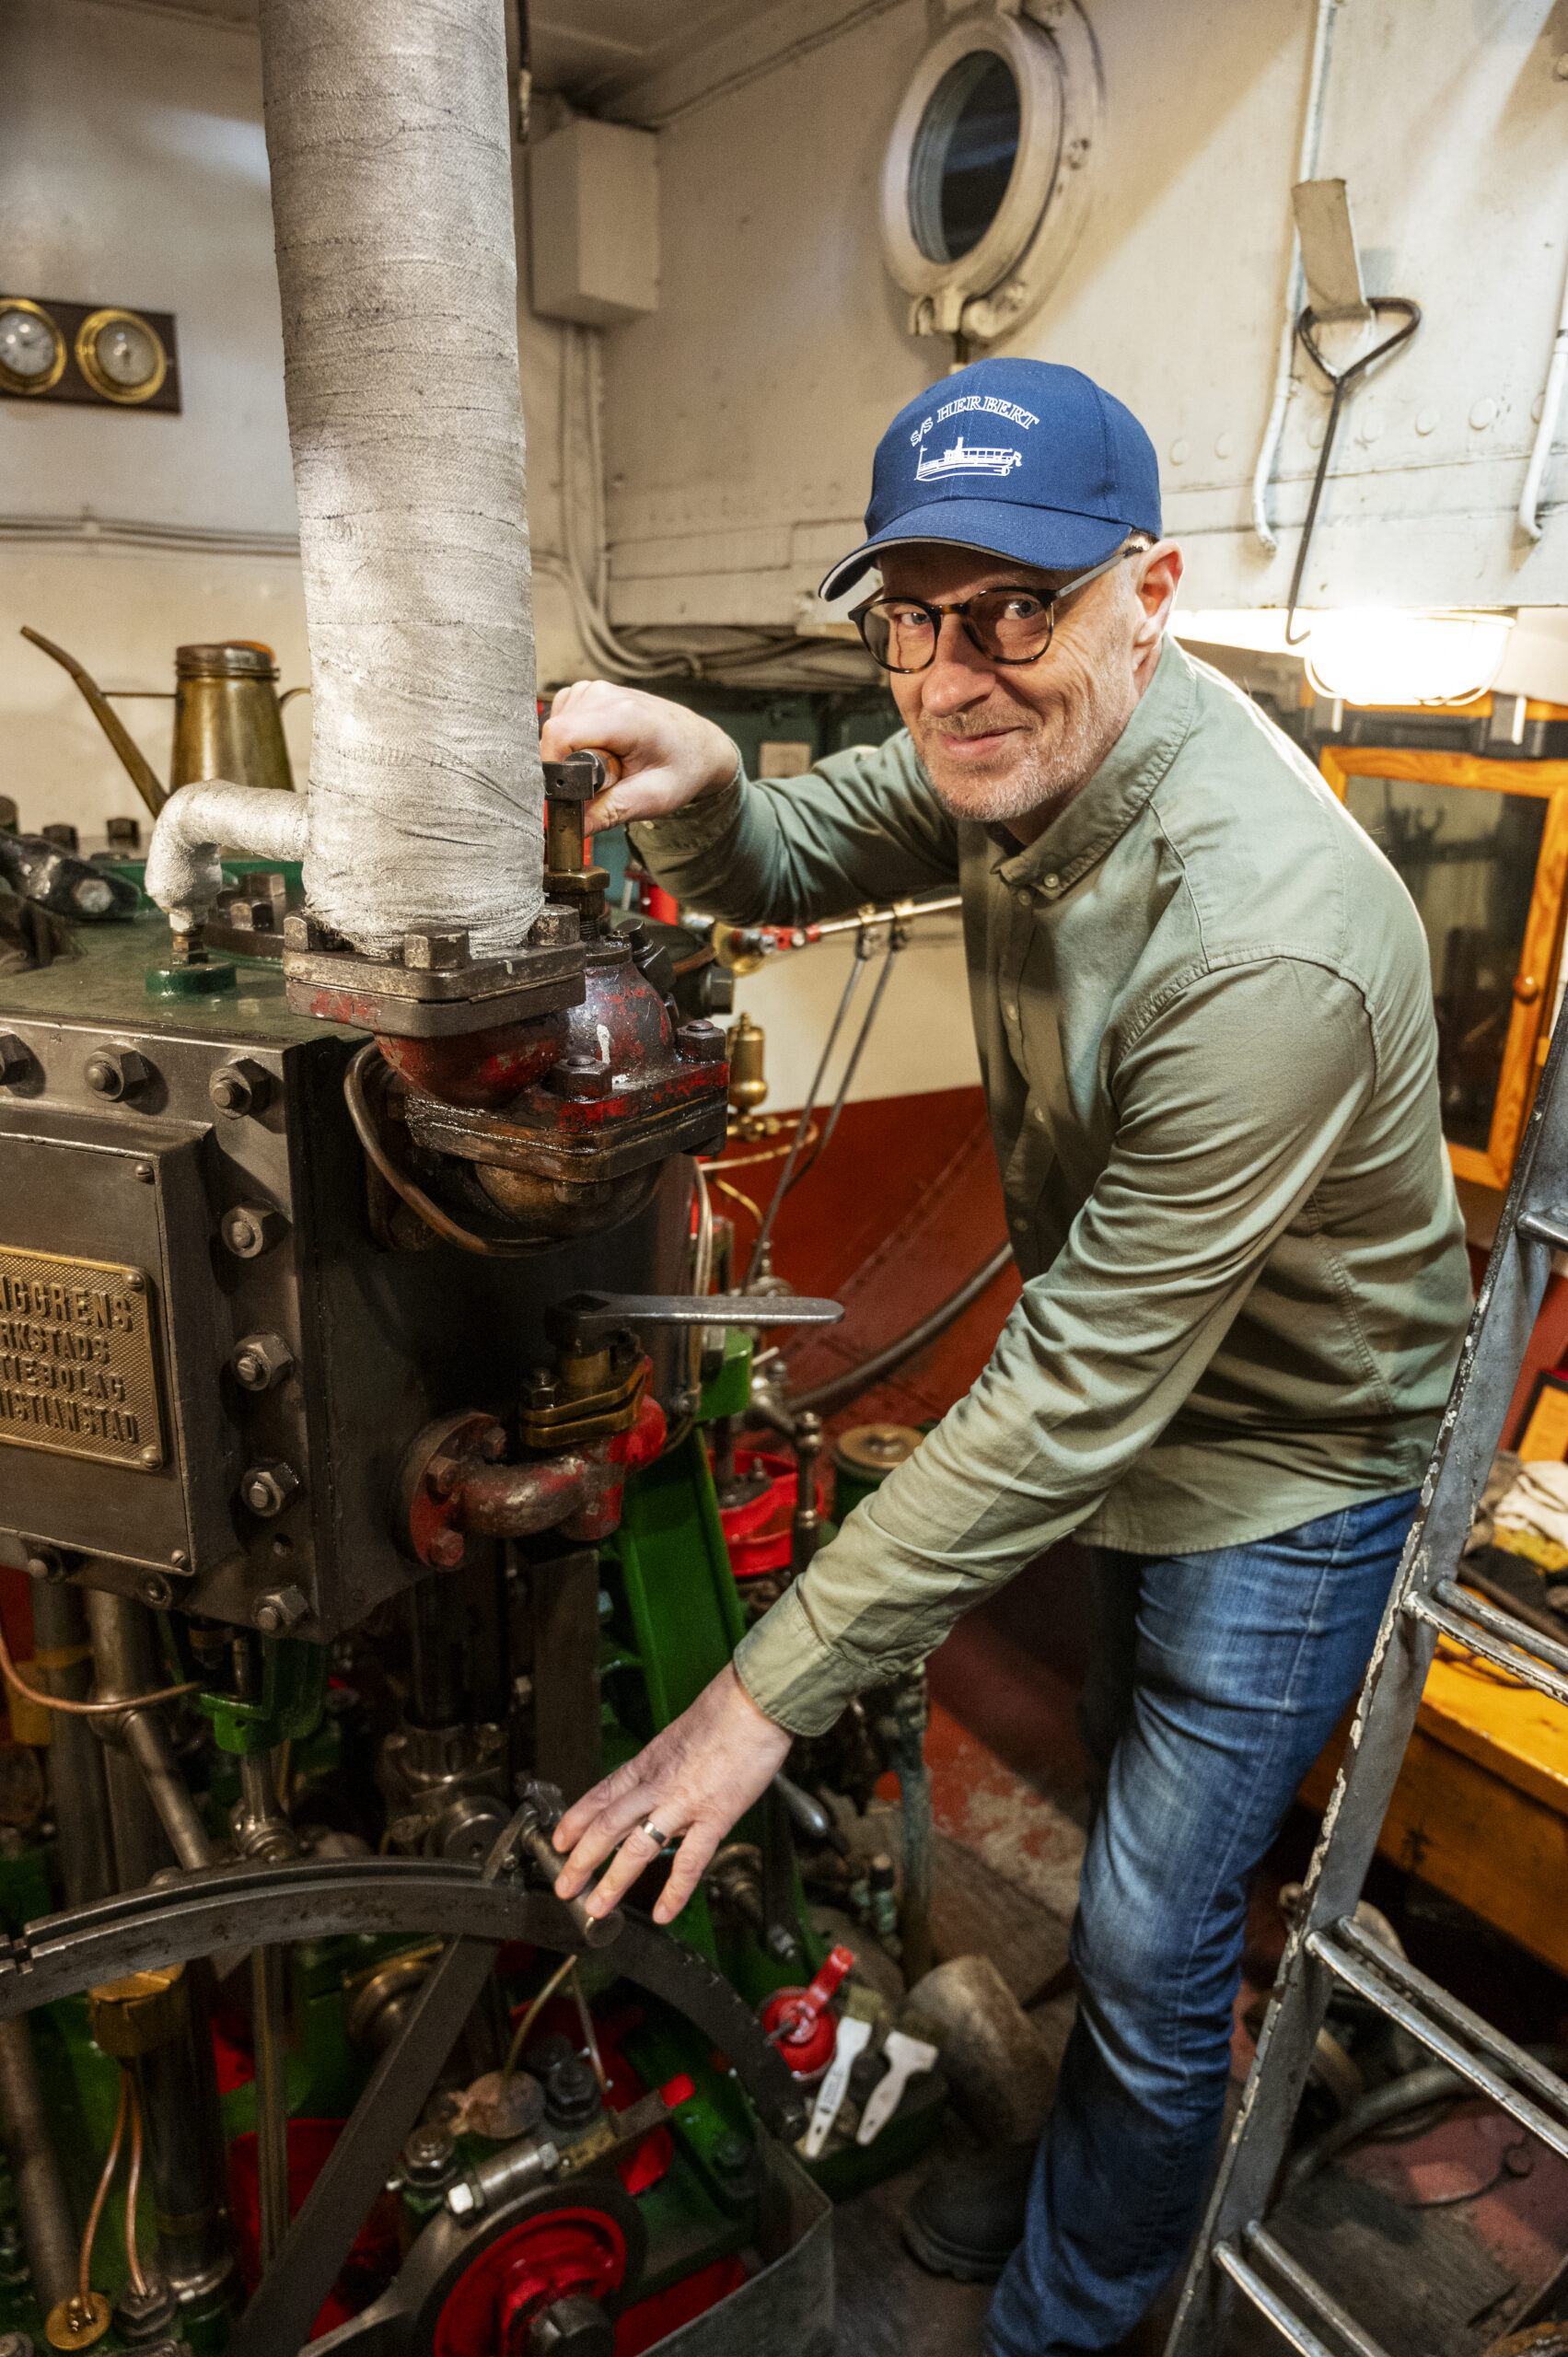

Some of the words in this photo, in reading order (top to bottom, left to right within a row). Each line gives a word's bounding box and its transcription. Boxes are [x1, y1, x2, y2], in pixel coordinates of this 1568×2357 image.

[910, 416, 934, 447] S/S
[936, 395, 1040, 430] HERBERT
[0, 1386, 139, 1443] ISTIANSTAD
